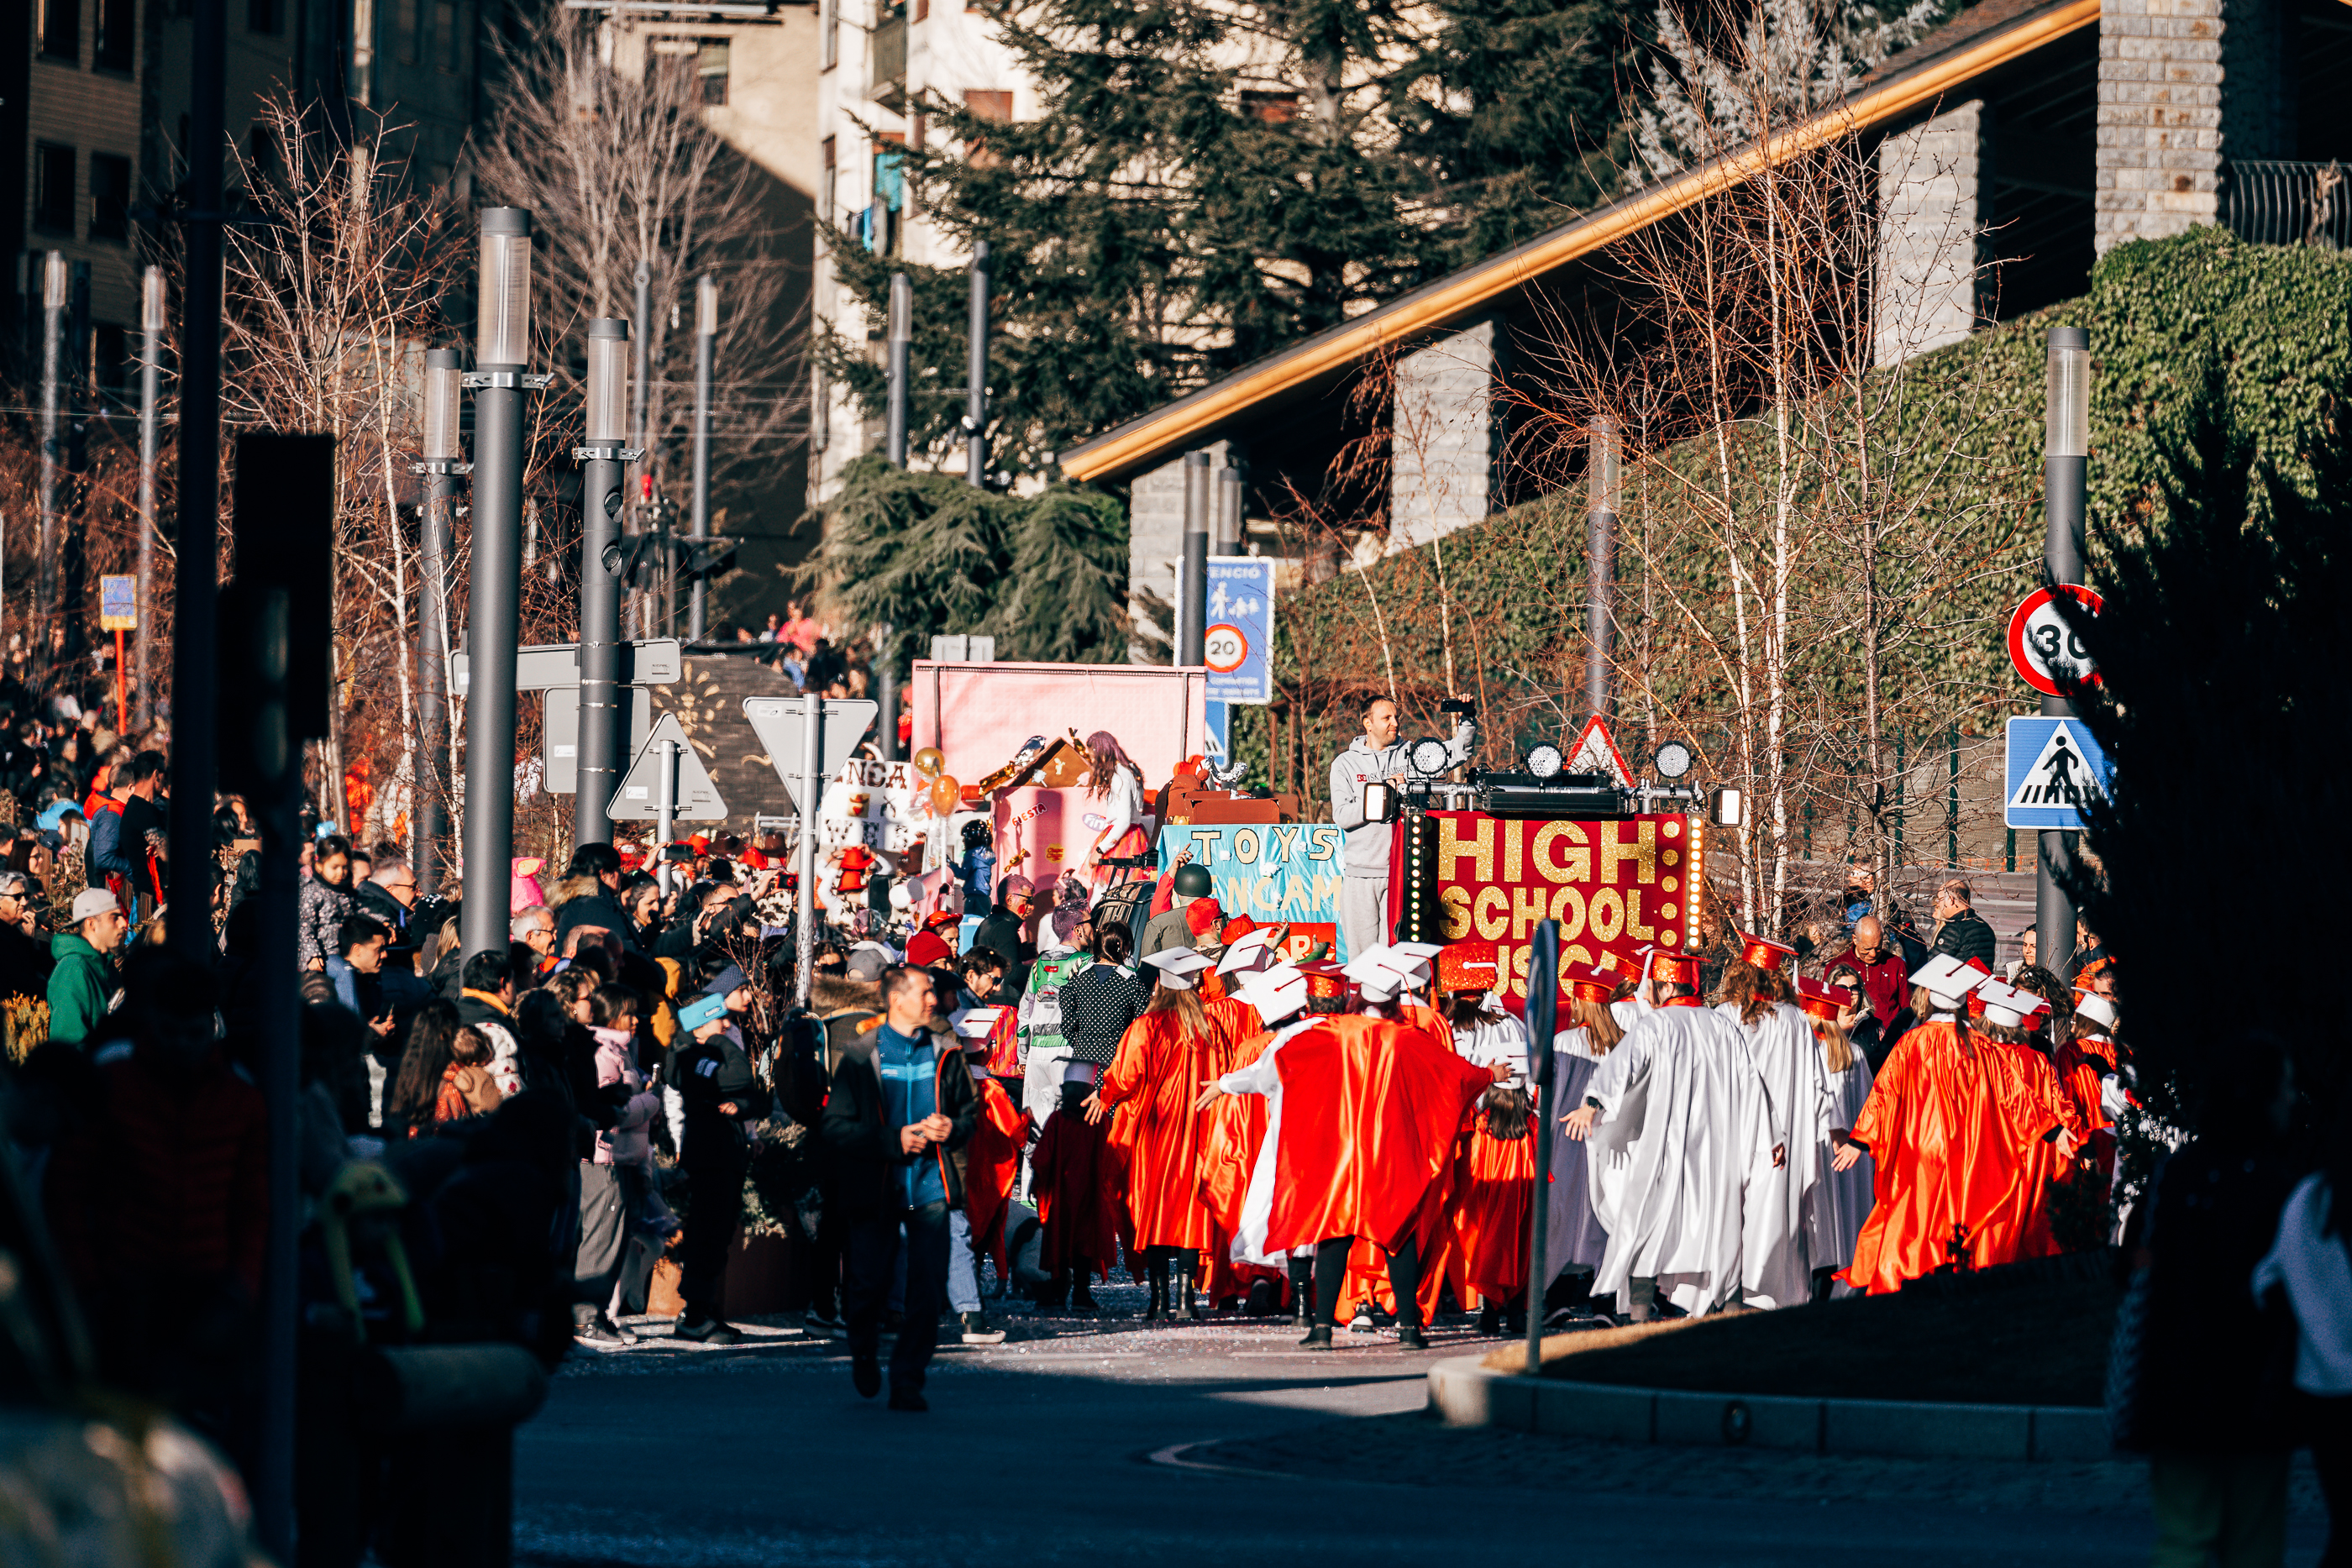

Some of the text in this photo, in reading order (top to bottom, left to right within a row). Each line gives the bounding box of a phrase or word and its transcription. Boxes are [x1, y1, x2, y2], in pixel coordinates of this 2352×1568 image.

[1208, 564, 1262, 579] ENCIÓ
[1210, 641, 1236, 655] 20
[834, 761, 907, 789] NCA
[1011, 803, 1047, 826] FIESTA
[1084, 814, 1108, 831] Fin
[1191, 826, 1339, 866] TOYS
[1438, 818, 1656, 884] HIGH
[1438, 886, 1655, 941] SCHOOL
